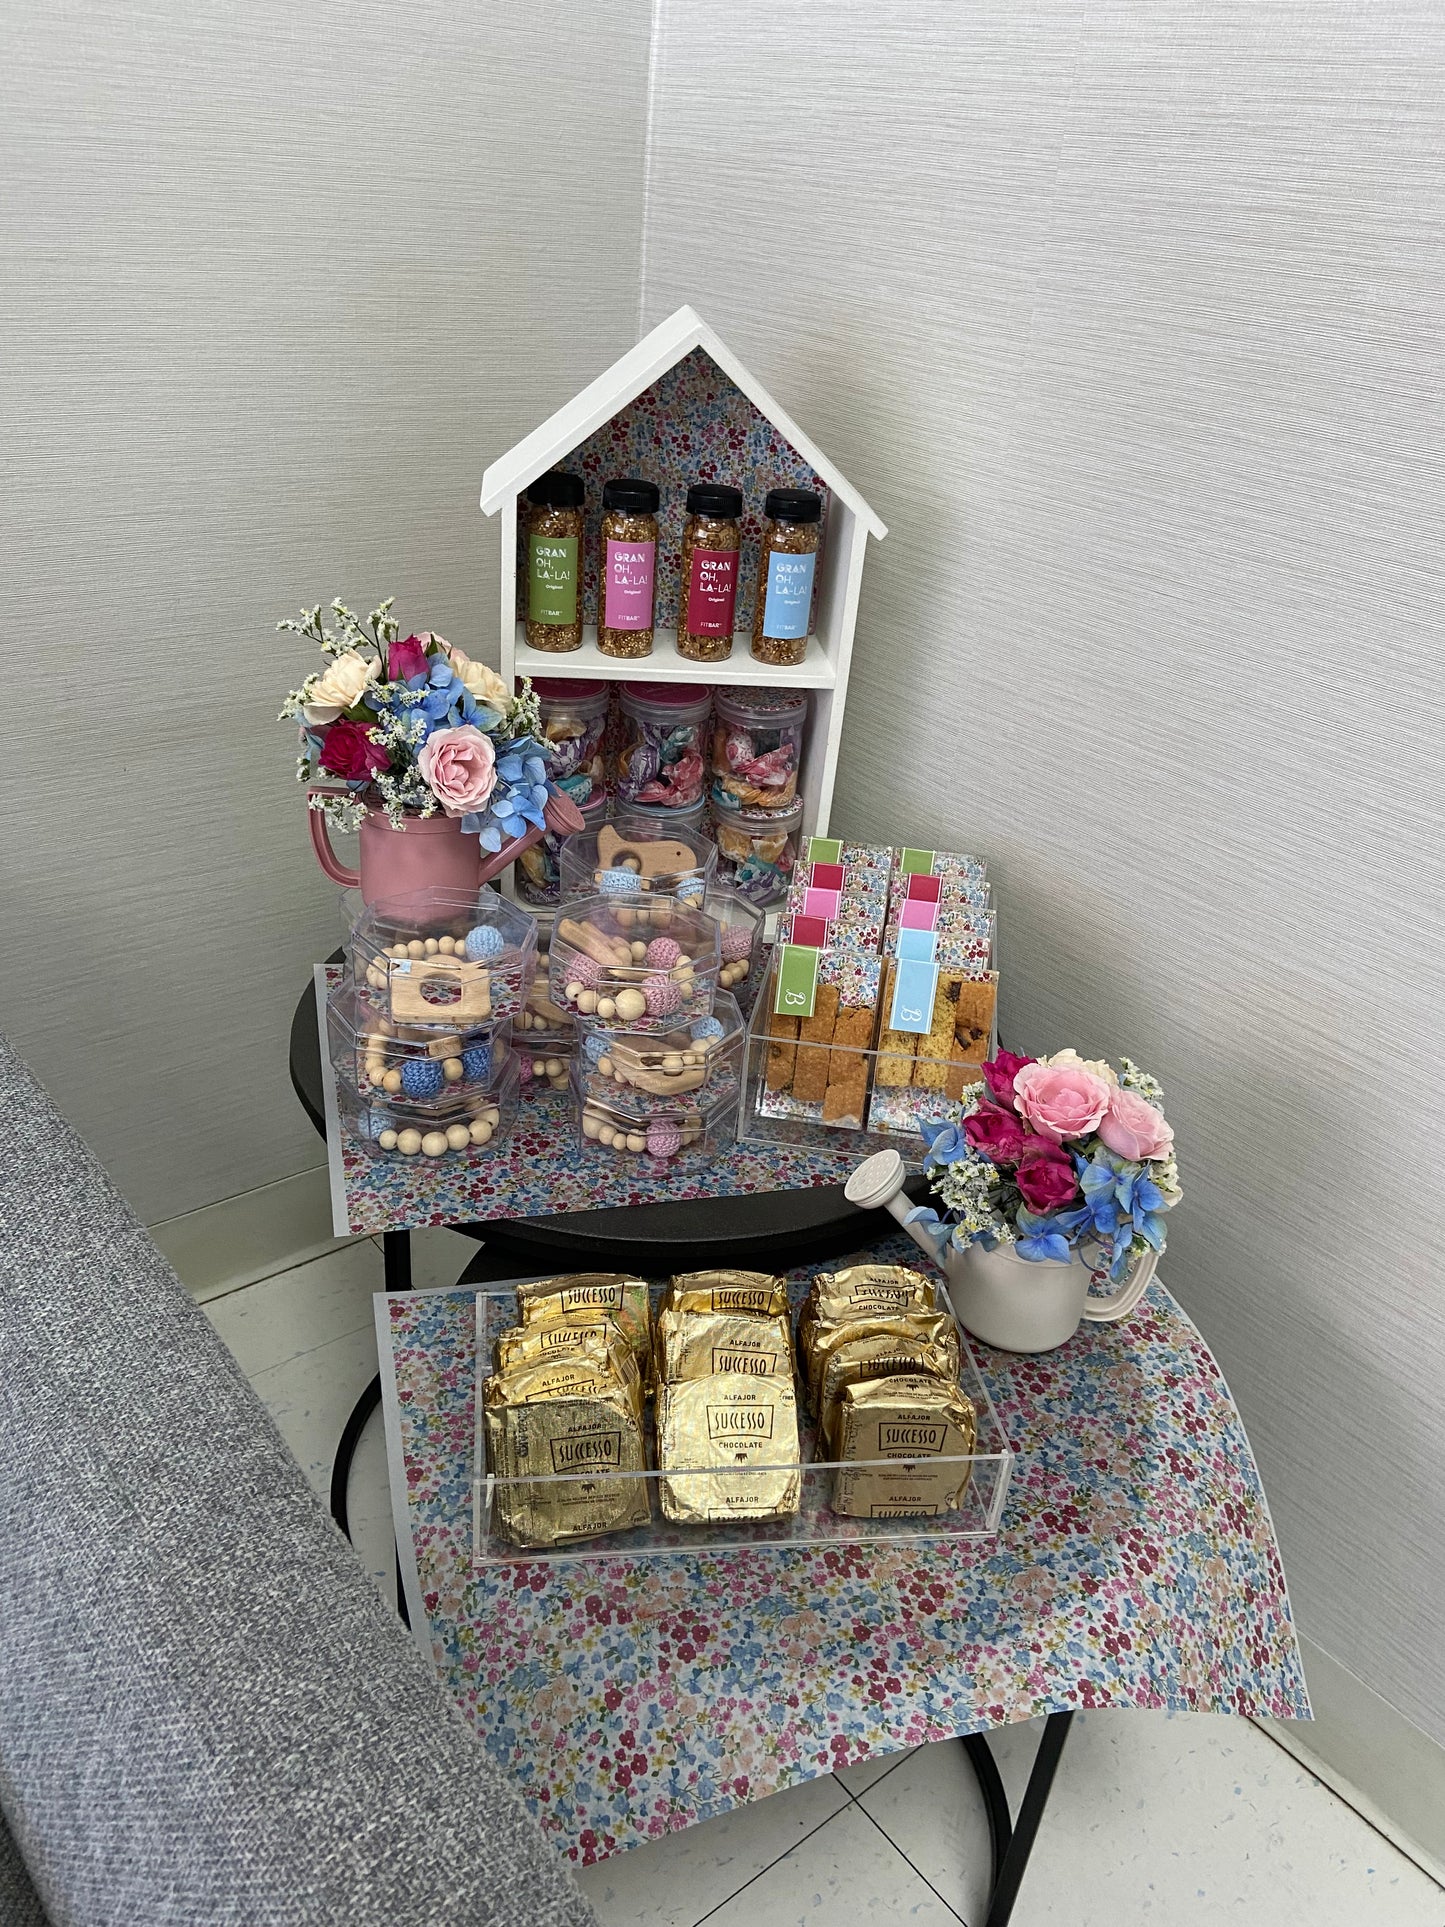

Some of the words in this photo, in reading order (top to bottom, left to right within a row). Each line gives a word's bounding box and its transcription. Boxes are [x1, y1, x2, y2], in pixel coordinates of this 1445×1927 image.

[535, 545, 567, 558] GRAN
[614, 551, 646, 563] GRAN
[701, 559, 731, 571] GRAN
[776, 562, 807, 573] GRAN
[537, 569, 571, 581] LA-LA!
[614, 574, 648, 586] LA-LA!
[699, 582, 732, 593] LA-LA!
[775, 585, 808, 596] LA-LA!
[568, 1287, 616, 1304] SUCCESSO
[718, 1290, 765, 1306] SUCCESSO
[729, 1339, 761, 1348] ALFAJOR
[718, 1355, 767, 1374] SUCCESSO
[542, 1373, 575, 1387] ALFAJOR
[888, 1378, 932, 1386] CHOCOLATE
[715, 1412, 765, 1431] SUCCESSO
[567, 1423, 602, 1433] ALFAJOR
[886, 1428, 937, 1444] SUCCESSO
[559, 1439, 612, 1463] SUCCESSO
[718, 1441, 764, 1449] CHOCOLATE
[572, 1521, 608, 1532] ALFAJOR
